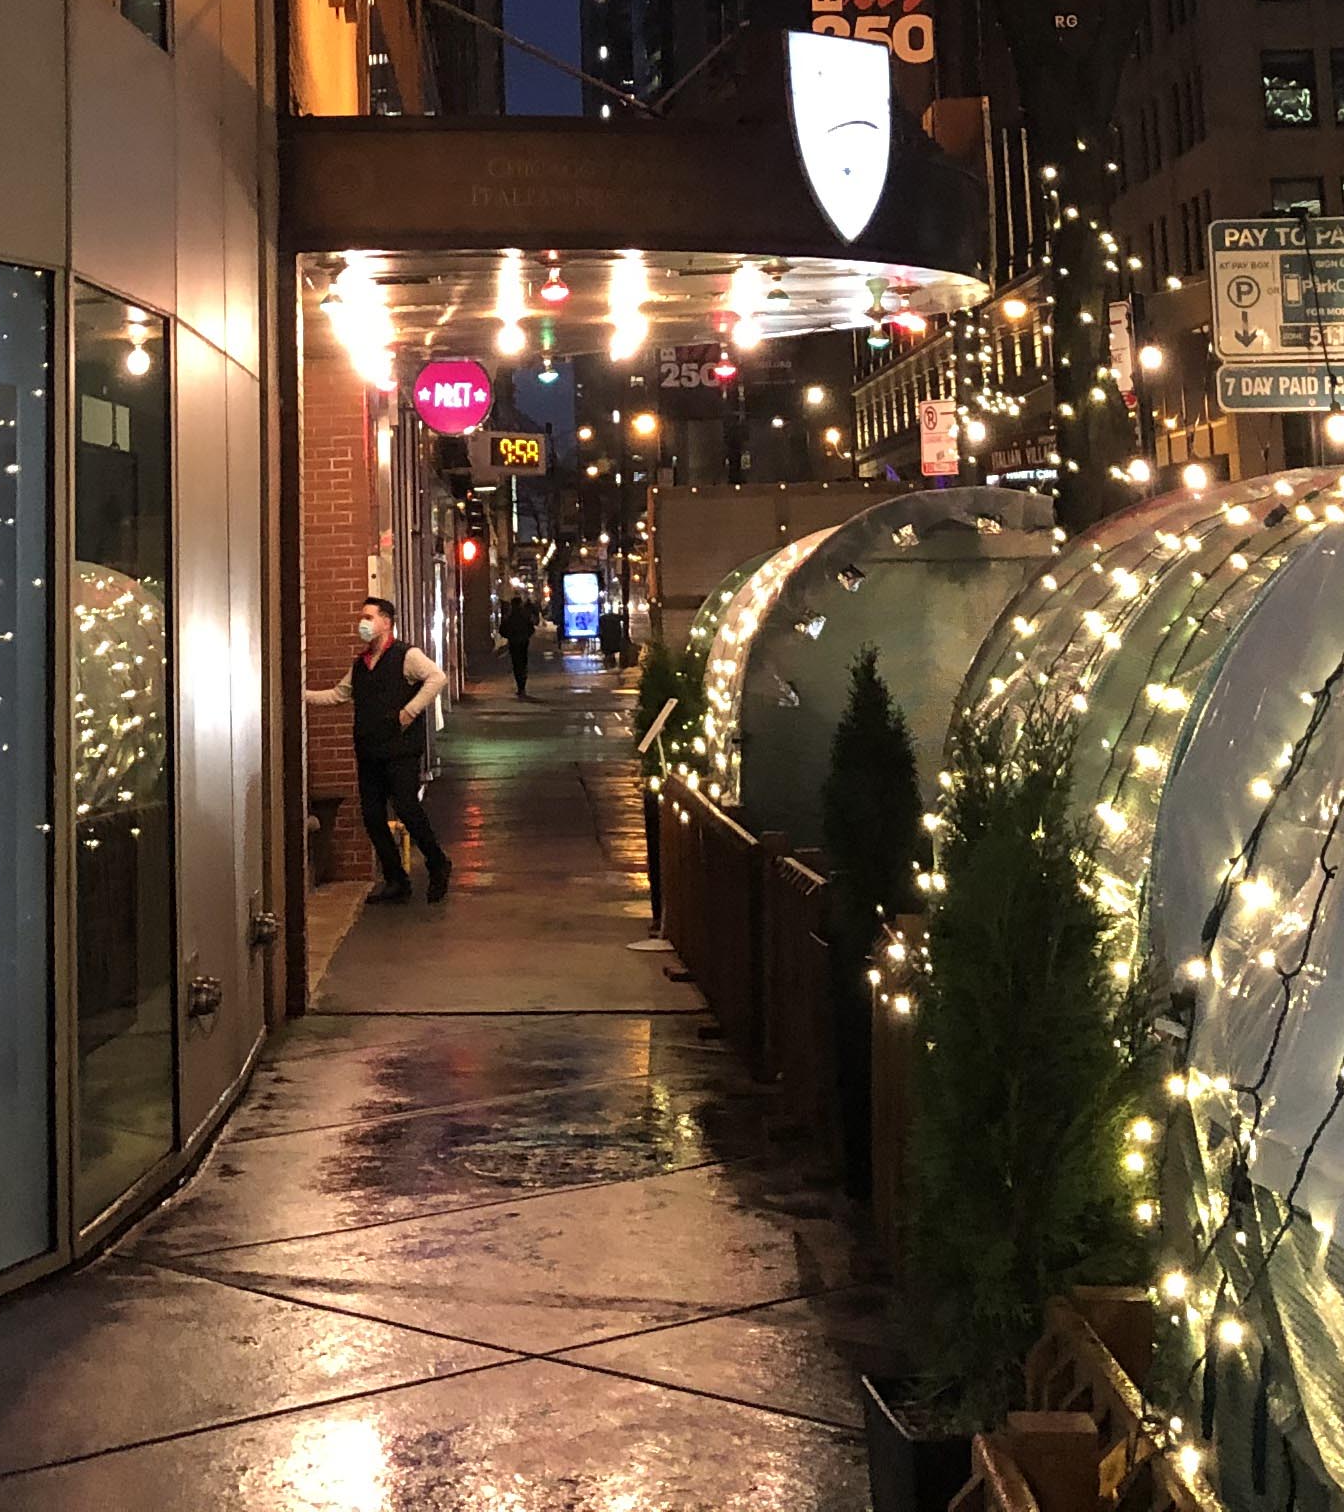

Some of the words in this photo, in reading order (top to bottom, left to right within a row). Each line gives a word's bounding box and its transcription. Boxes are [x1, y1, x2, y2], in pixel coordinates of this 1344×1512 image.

[1223, 227, 1269, 248] PAY
[1250, 261, 1269, 269] BOX
[1225, 378, 1235, 396] 7
[1242, 377, 1272, 396] DAY
[1279, 376, 1319, 395] PAID
